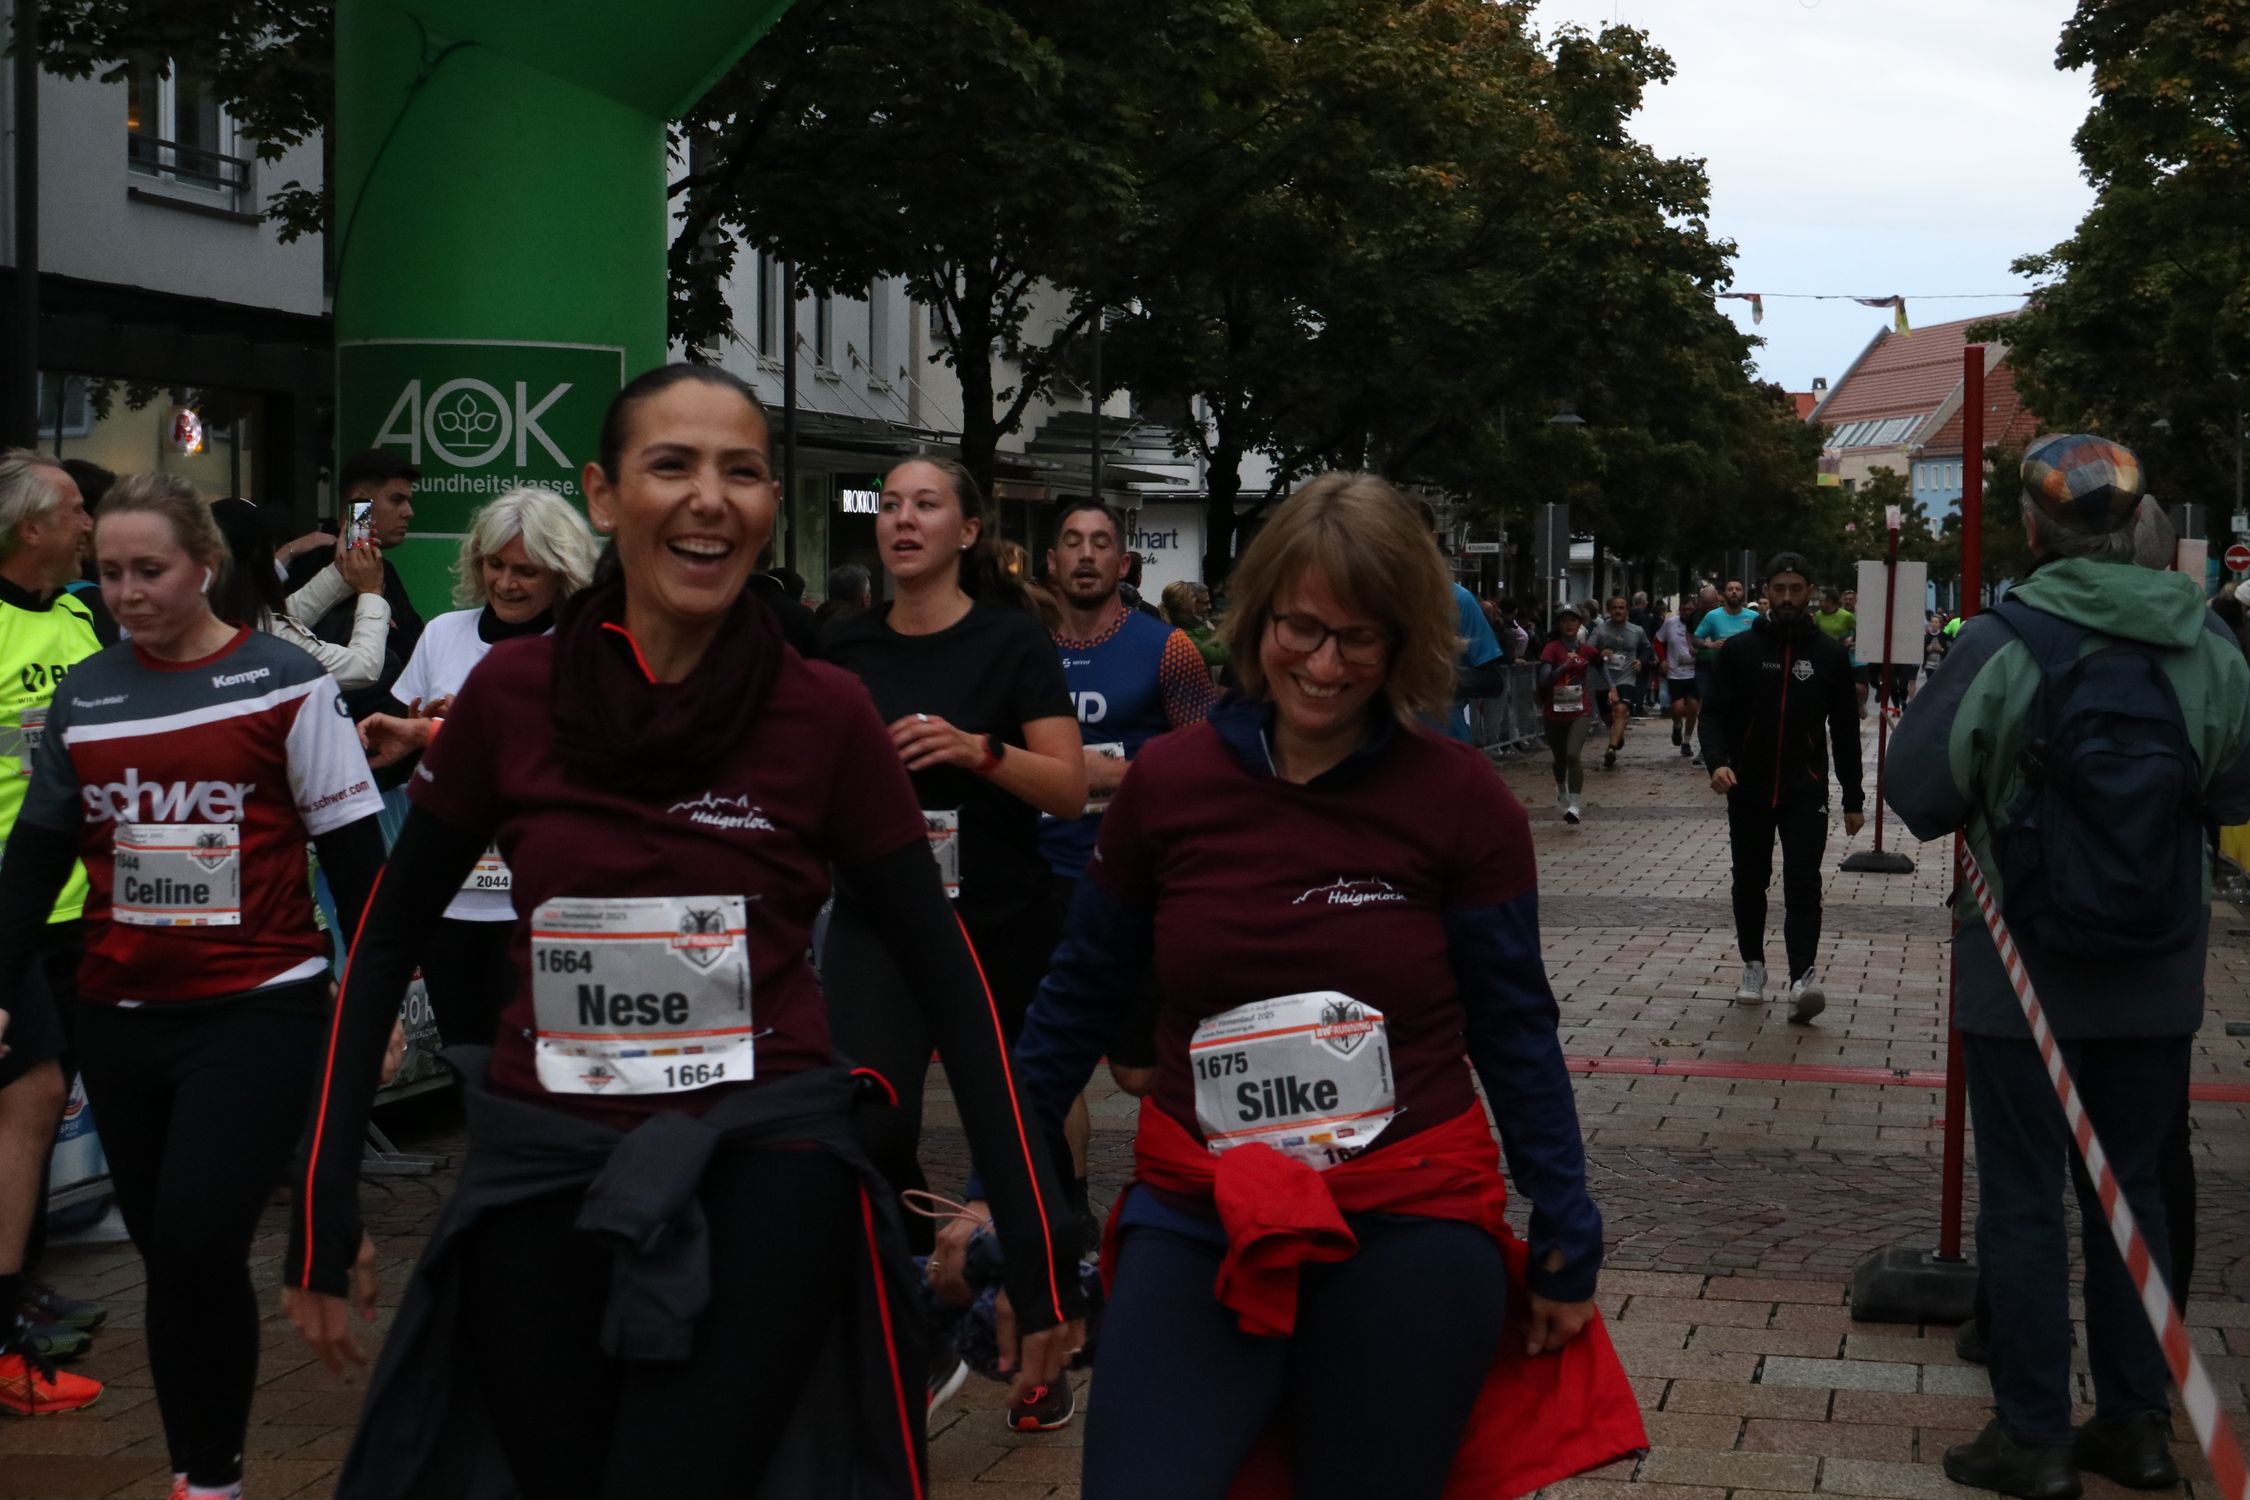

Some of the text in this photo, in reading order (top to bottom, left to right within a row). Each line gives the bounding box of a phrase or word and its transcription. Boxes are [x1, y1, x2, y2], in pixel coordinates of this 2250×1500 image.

[371, 377, 575, 468] AOK
[211, 667, 271, 689] Kempa
[81, 768, 257, 824] schwer
[124, 875, 210, 905] Celine
[477, 875, 509, 888] 2044
[537, 949, 592, 973] 1664
[577, 984, 689, 1027] Nese
[664, 1062, 725, 1088] 1664
[1196, 1051, 1248, 1080] 1675
[1236, 1075, 1339, 1122] Silke
